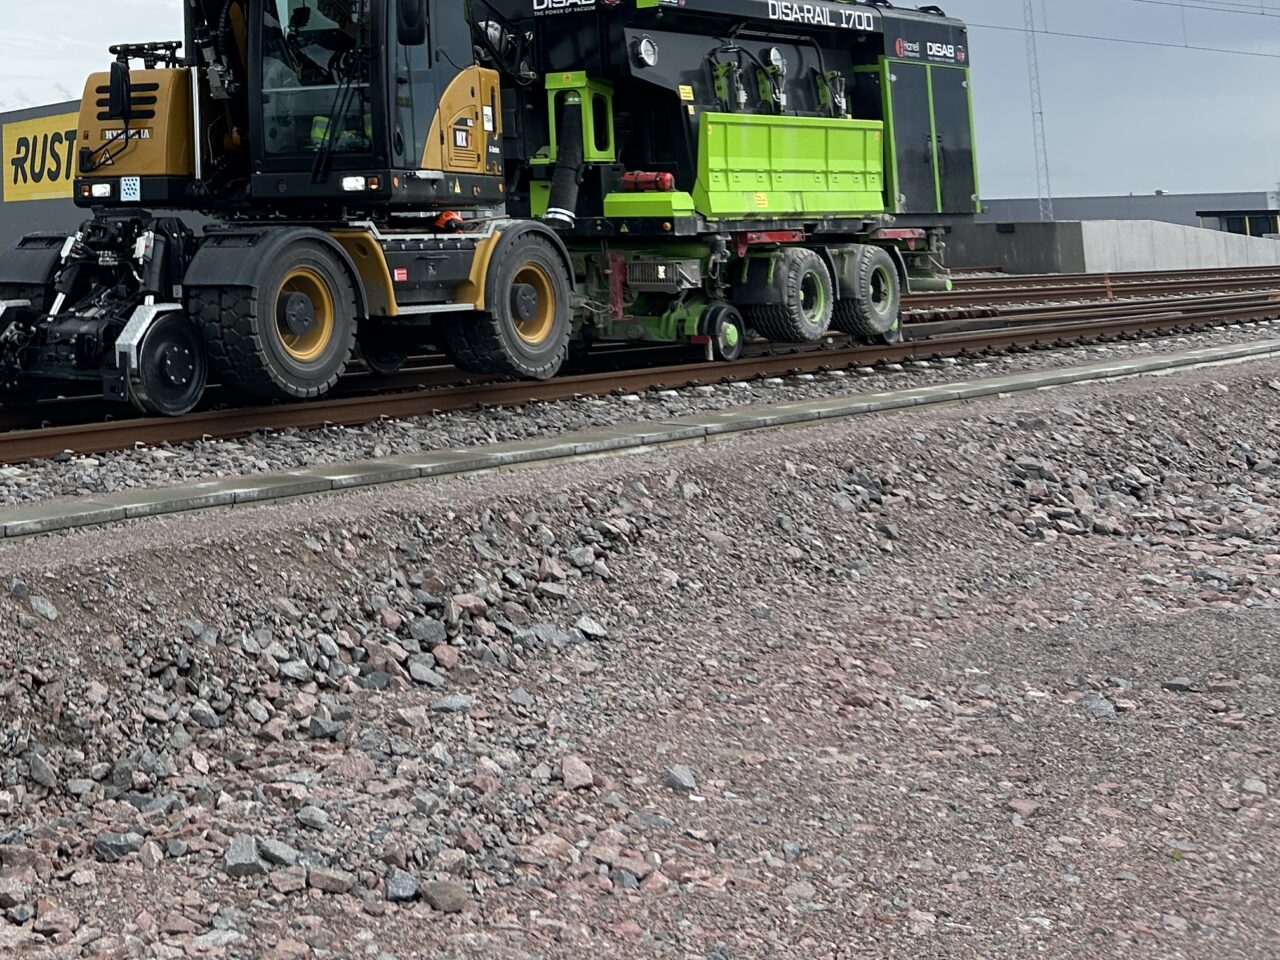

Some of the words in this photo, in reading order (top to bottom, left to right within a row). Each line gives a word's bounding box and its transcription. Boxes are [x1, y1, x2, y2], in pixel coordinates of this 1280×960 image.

[768, 0, 836, 27] DISA-RAIL
[839, 9, 874, 31] 1700
[926, 42, 955, 57] DISAB
